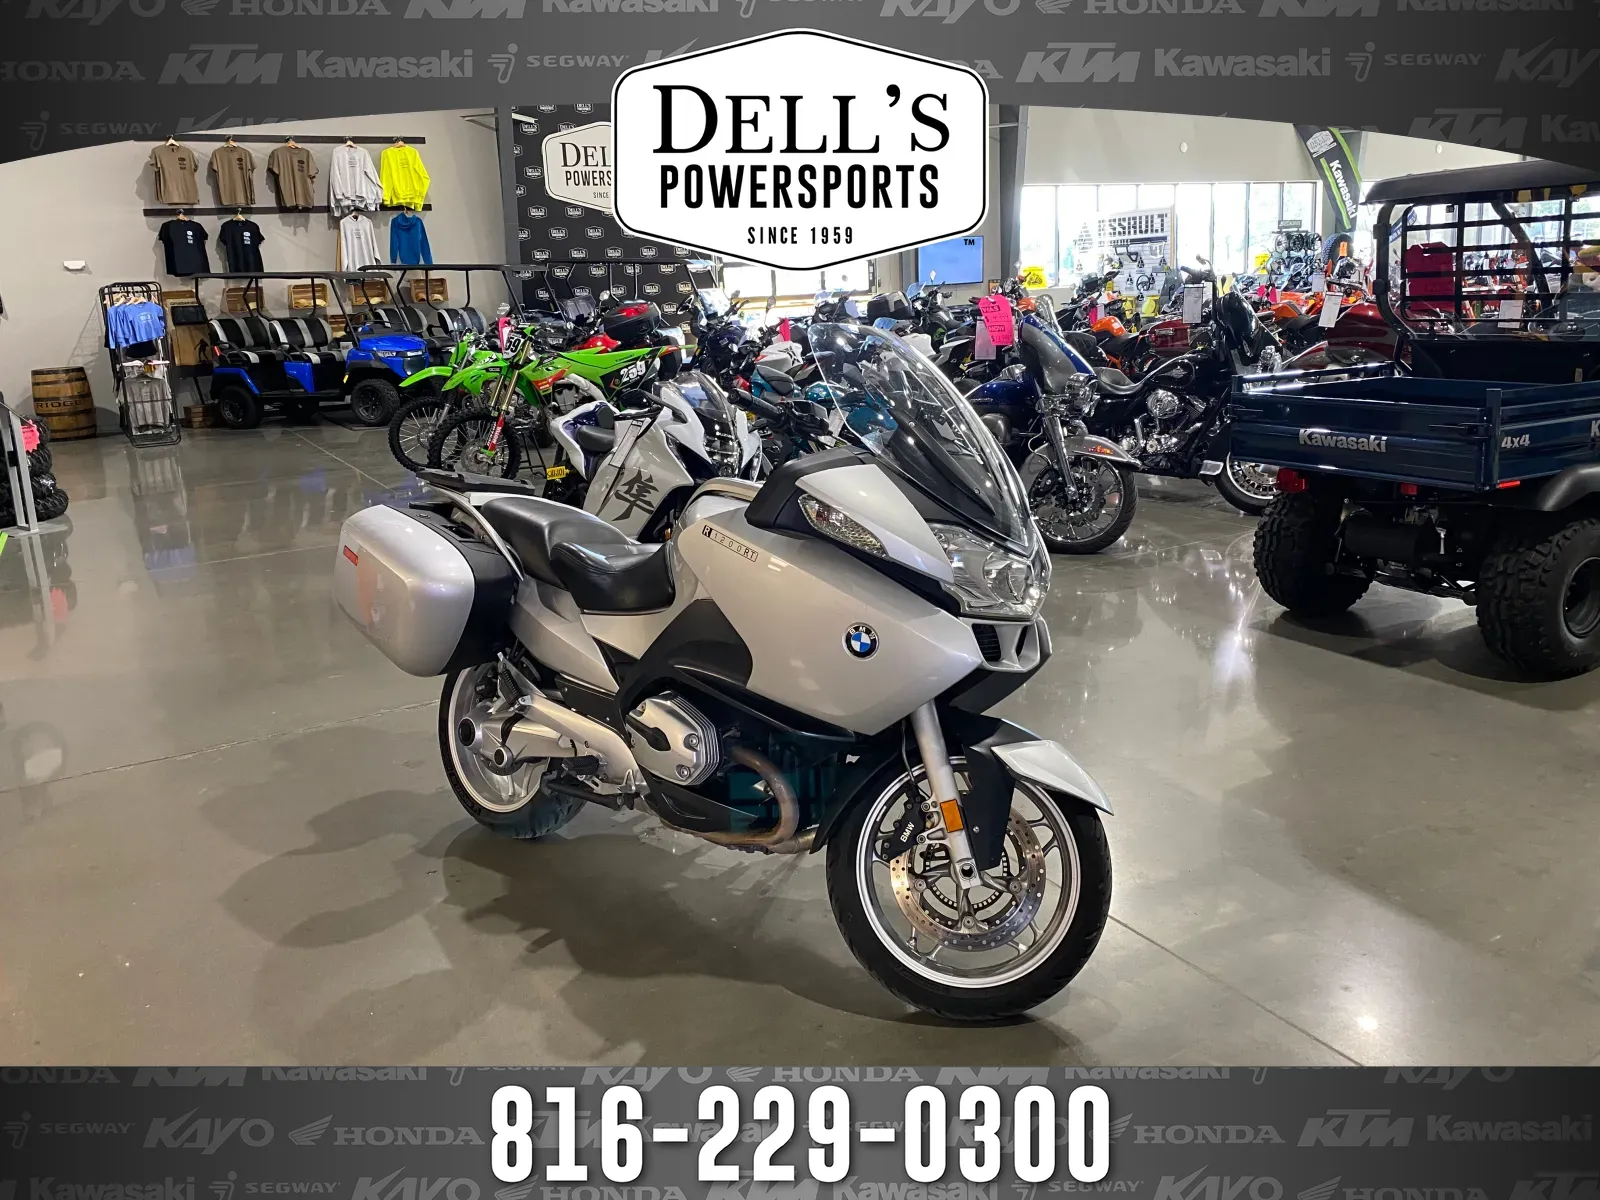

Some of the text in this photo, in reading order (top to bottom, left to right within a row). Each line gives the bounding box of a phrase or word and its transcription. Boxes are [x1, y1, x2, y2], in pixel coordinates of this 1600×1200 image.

[559, 142, 611, 167] DEL
[565, 171, 611, 186] POWERS
[1330, 160, 1357, 218] Kawasaki
[620, 361, 646, 382] 259
[1299, 429, 1387, 452] Kawasaki
[1501, 434, 1530, 449] 4x4
[612, 467, 659, 521] 隼
[900, 822, 915, 842] BMW
